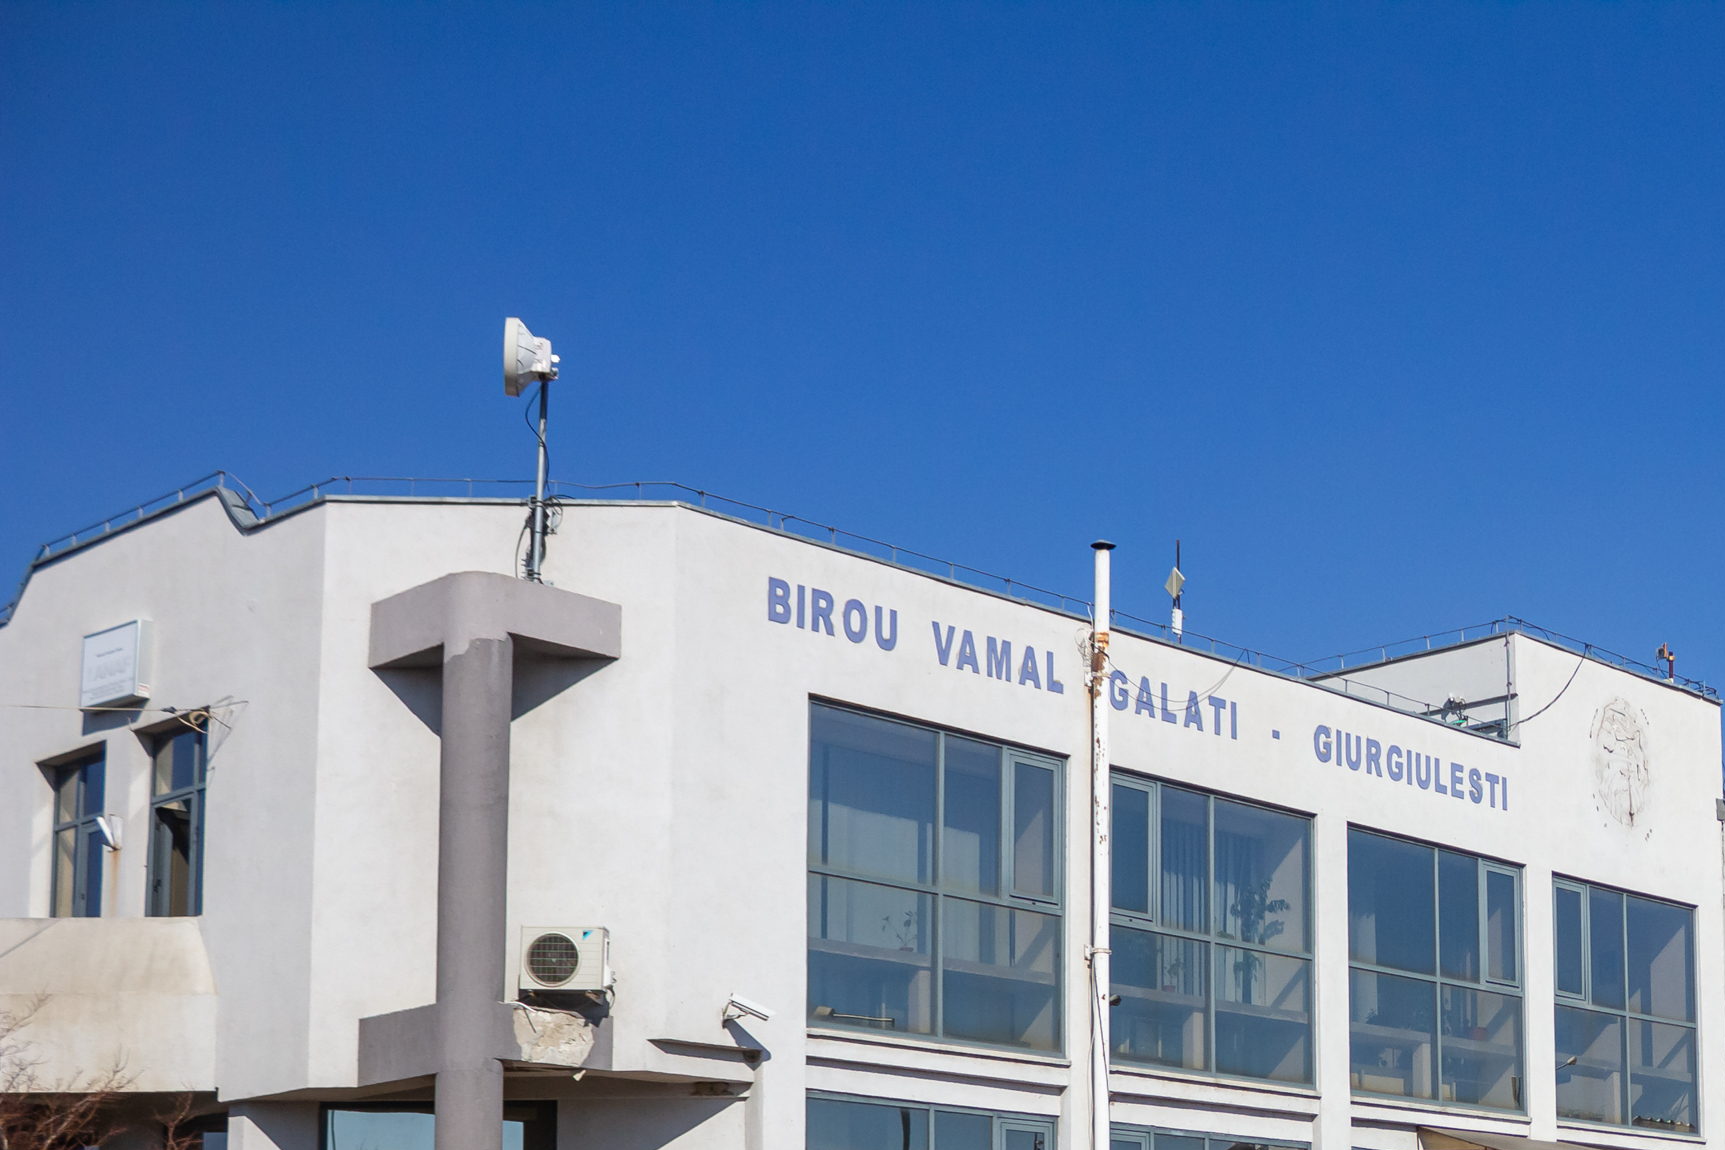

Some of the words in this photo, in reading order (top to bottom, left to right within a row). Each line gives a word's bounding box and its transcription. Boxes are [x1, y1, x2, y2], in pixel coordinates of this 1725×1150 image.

[768, 577, 898, 651] BIROU
[932, 621, 1064, 694] VAMAL
[1109, 670, 1238, 740] GALATI
[1313, 724, 1508, 811] GIURGIULESTI
